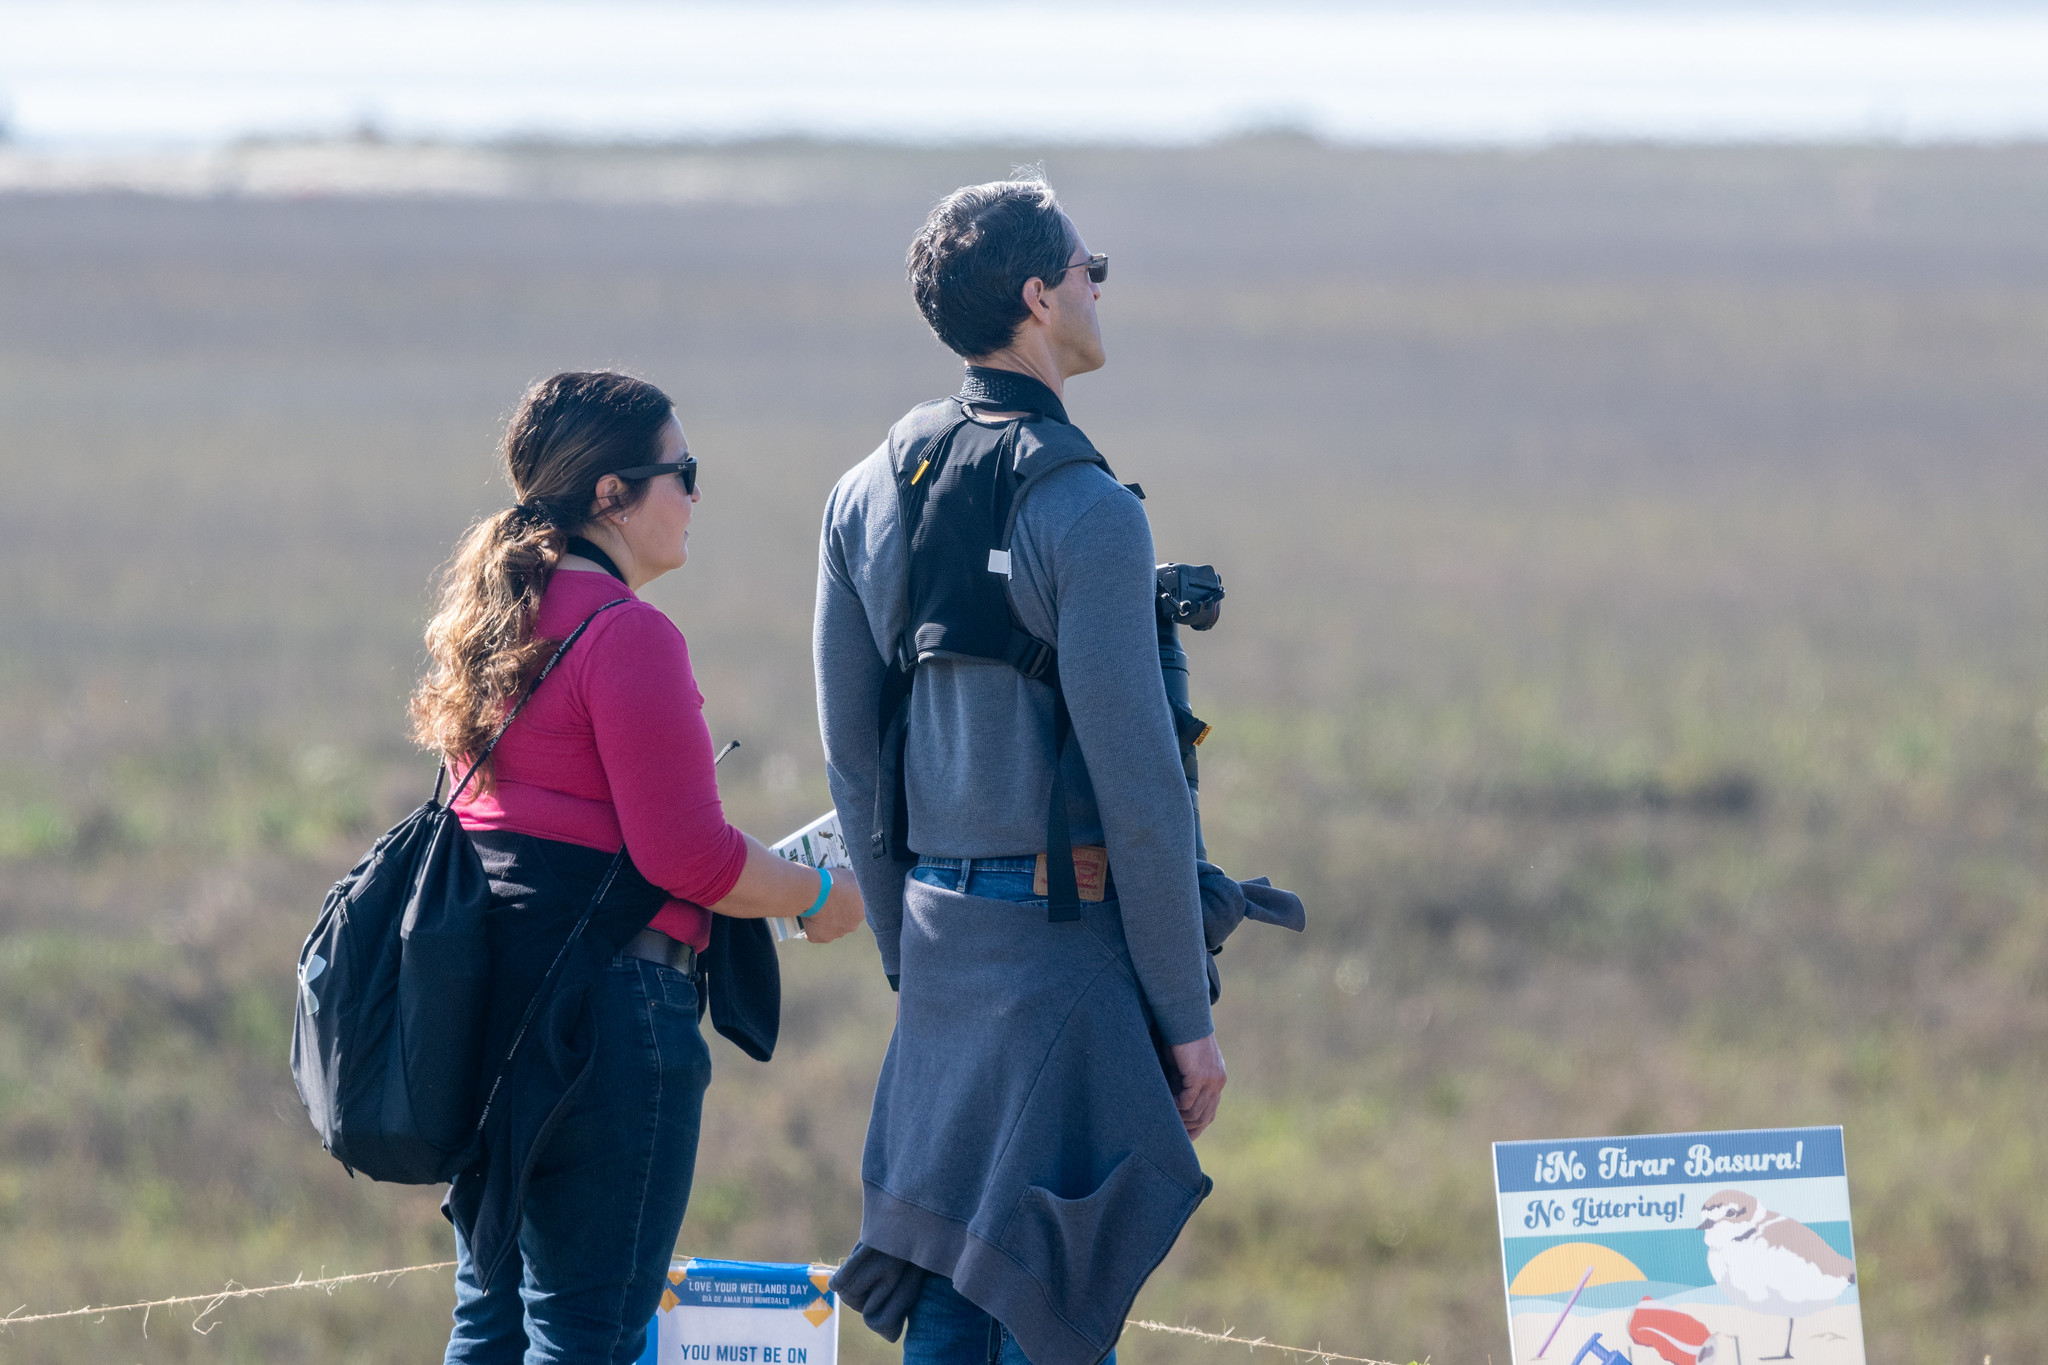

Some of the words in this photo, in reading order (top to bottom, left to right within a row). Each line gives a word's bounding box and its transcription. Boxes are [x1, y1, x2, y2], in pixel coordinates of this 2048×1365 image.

[540, 653, 559, 680] UNDER
[1534, 1150, 1587, 1184] ¡No
[1598, 1146, 1676, 1180] Tirar
[1684, 1140, 1803, 1177] Basura!
[1524, 1199, 1566, 1229] No
[1572, 1193, 1685, 1227] Littering!
[689, 1281, 712, 1292] LOVE
[714, 1282, 737, 1293] YOUR
[740, 1283, 788, 1295] WETLANDS
[790, 1284, 809, 1295] DAY
[723, 1296, 741, 1304] AMAR
[742, 1296, 754, 1304] TUS
[681, 1344, 711, 1361] YOU
[716, 1345, 757, 1362] MUST
[763, 1346, 782, 1363] BE
[787, 1348, 807, 1364] ON
